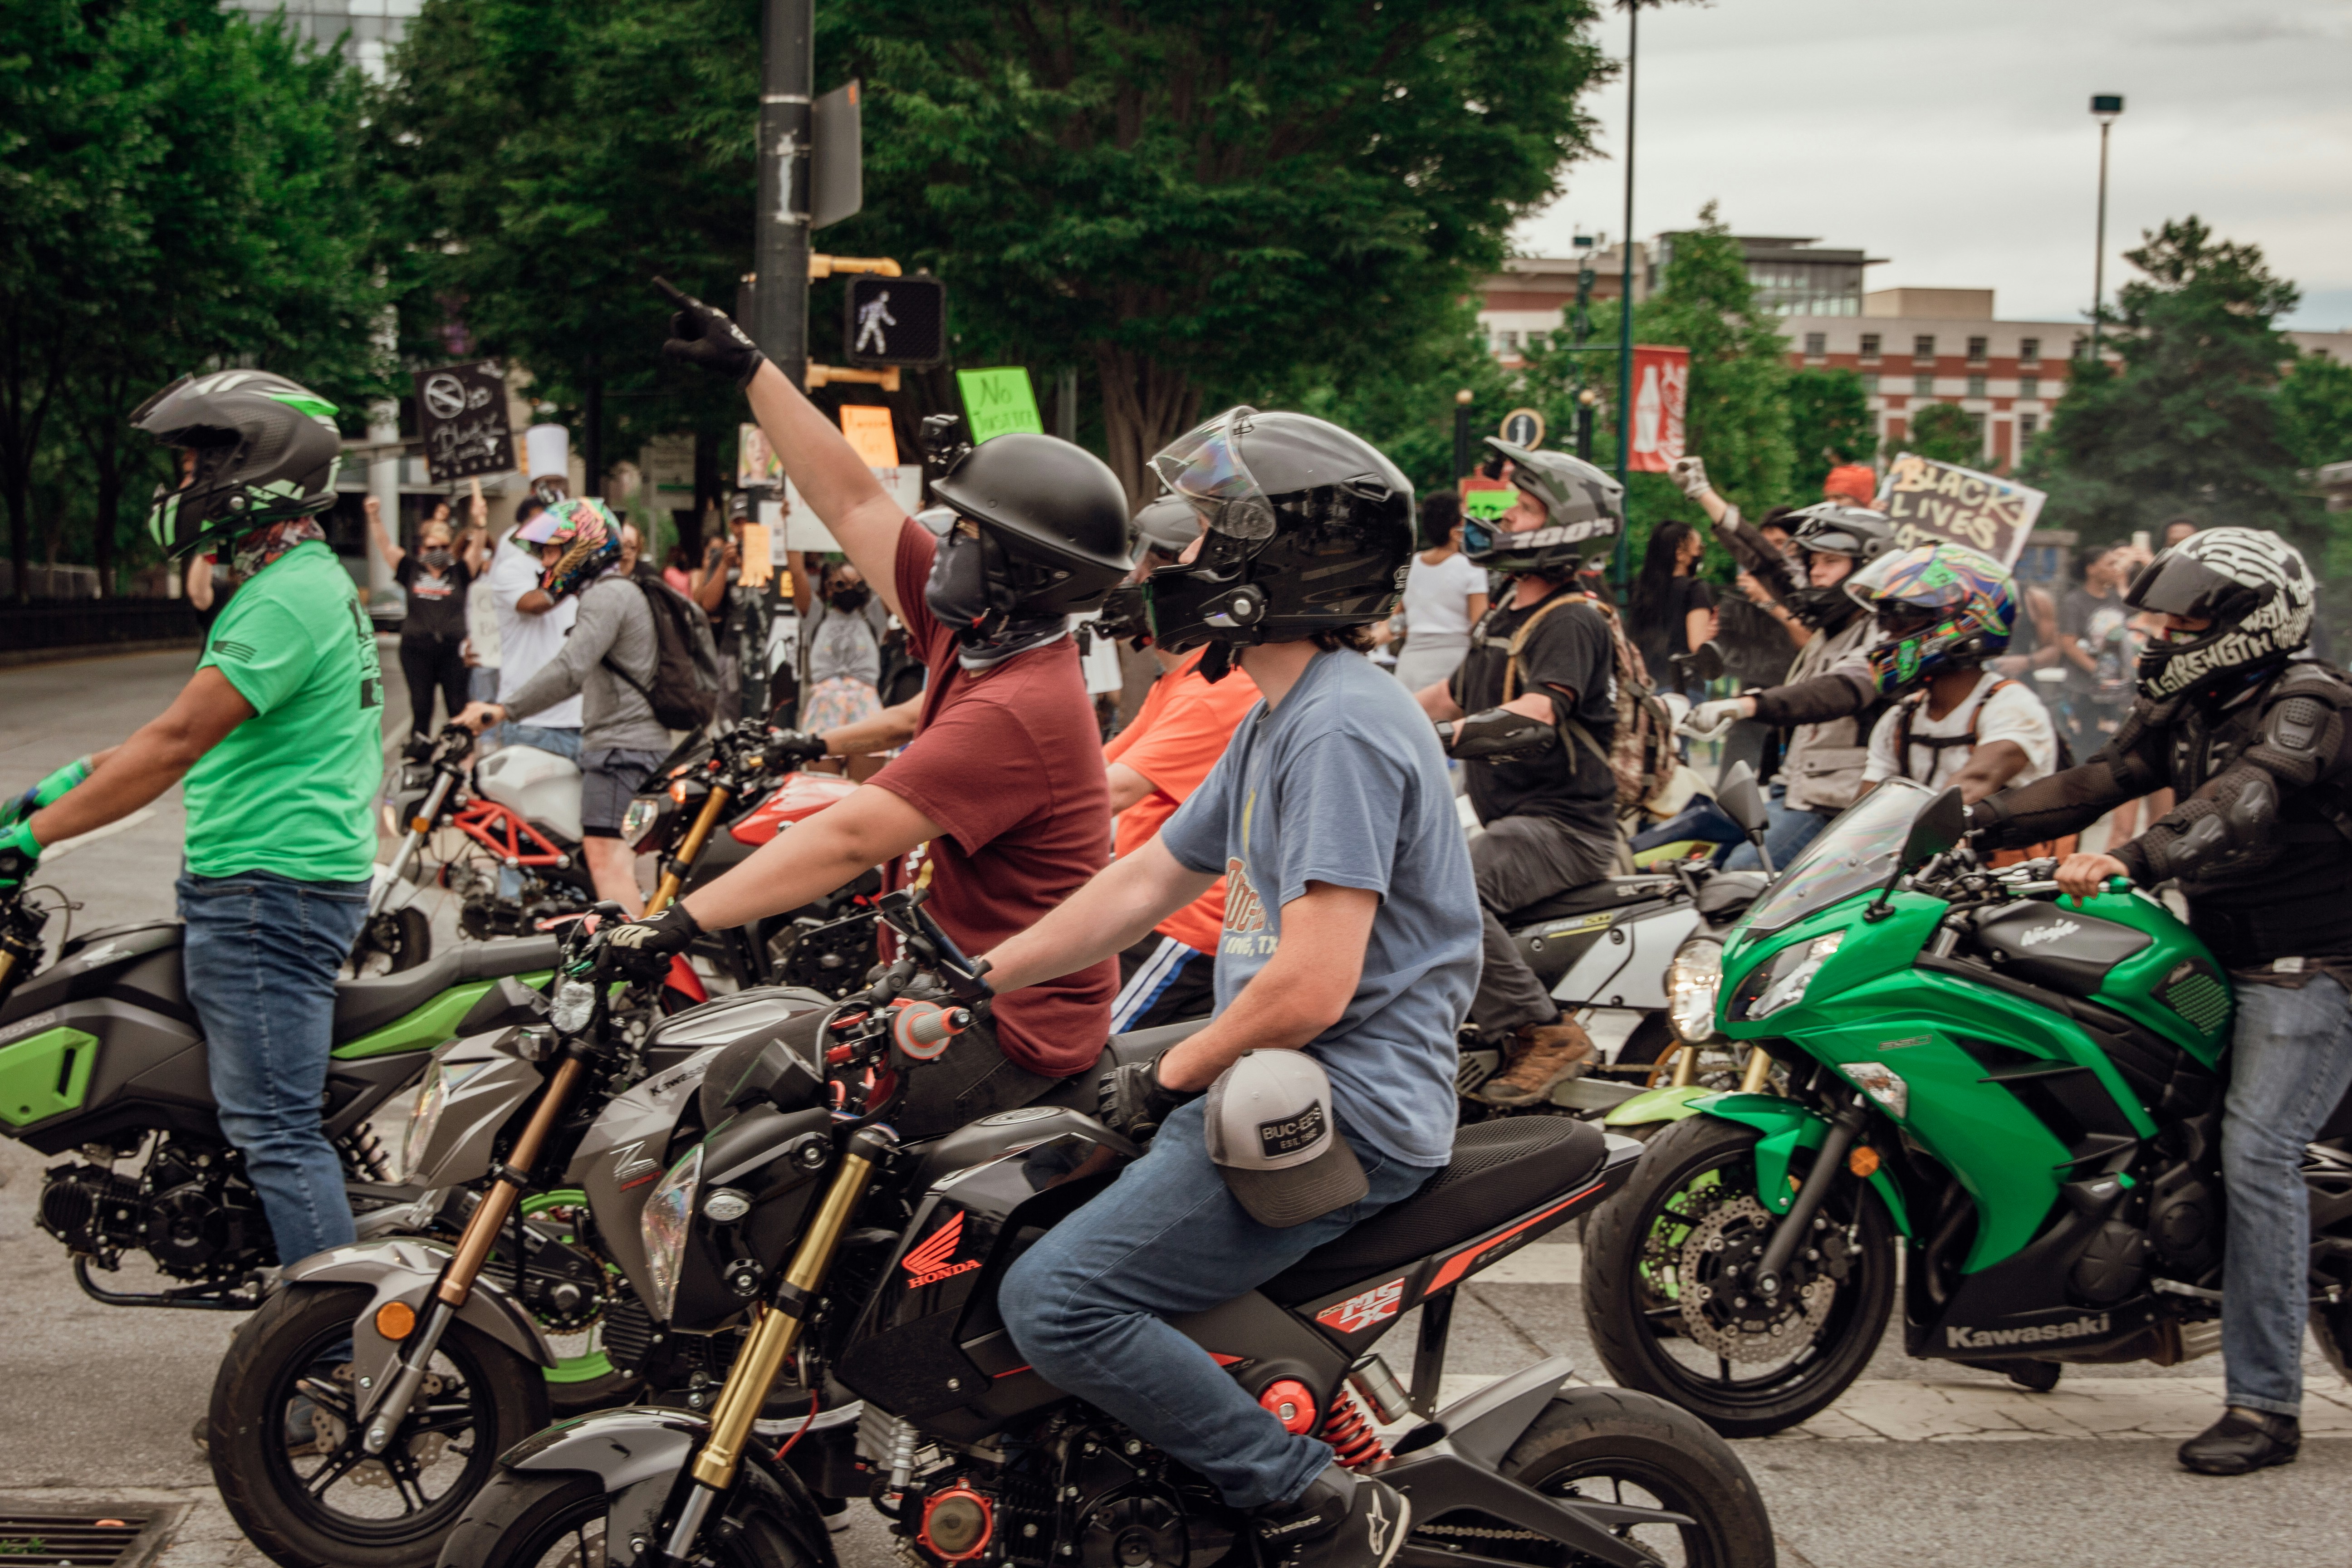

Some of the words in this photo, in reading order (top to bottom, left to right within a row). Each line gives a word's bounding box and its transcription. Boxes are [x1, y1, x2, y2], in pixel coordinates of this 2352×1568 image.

[980, 375, 1013, 407] No
[1510, 517, 1614, 549] 100%
[1891, 493, 1997, 550] LIVES
[1257, 936, 1279, 954] TX
[2020, 918, 2080, 946] Ninja
[907, 1259, 983, 1289] HONDA
[1946, 1313, 2110, 1348] Kawasaki
